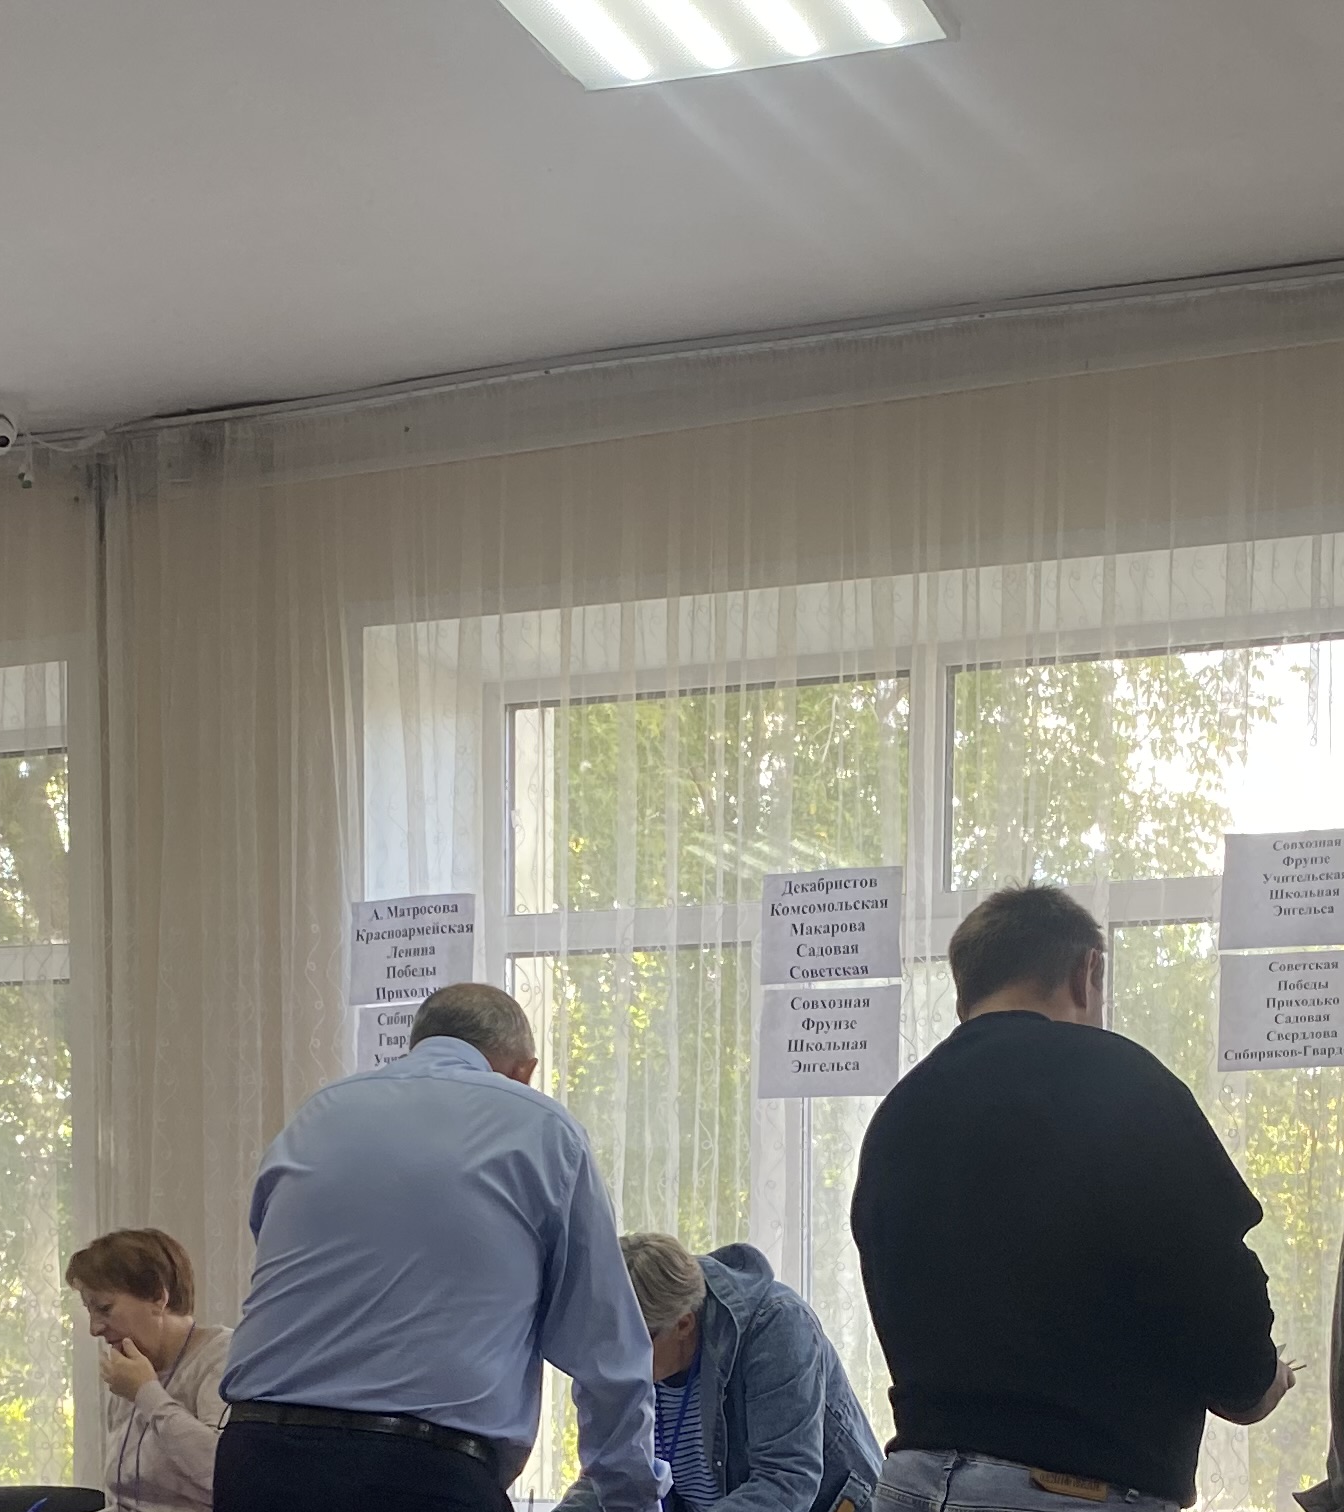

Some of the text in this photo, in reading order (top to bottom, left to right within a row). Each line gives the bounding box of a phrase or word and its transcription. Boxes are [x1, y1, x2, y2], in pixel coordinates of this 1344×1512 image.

[1272, 838, 1342, 852] Совхозная
[1282, 855, 1331, 869] Фрунзе
[781, 877, 878, 897] Декабристов
[1269, 887, 1340, 901] Школьная
[368, 903, 459, 921] А. Матросова
[769, 898, 889, 917] Комсомольская
[1272, 905, 1335, 917] Энгельса
[355, 922, 474, 945] Красноармейская
[789, 921, 866, 938] Макарова
[386, 945, 436, 960] Ленина
[796, 943, 859, 959] Садовая
[386, 965, 437, 980] Победы
[789, 965, 869, 980] Советская
[1268, 961, 1339, 973] Советская
[1277, 979, 1329, 992] Победы
[790, 996, 870, 1011] Совхозная
[1266, 996, 1340, 1011] Приходько
[377, 1012, 414, 1028] Сибир
[1274, 1012, 1331, 1025] Садовая
[801, 1018, 858, 1035] Фрунзе
[1266, 1029, 1338, 1043] Свердлова
[787, 1039, 868, 1053] Школьная
[791, 1060, 860, 1074] Энгельса
